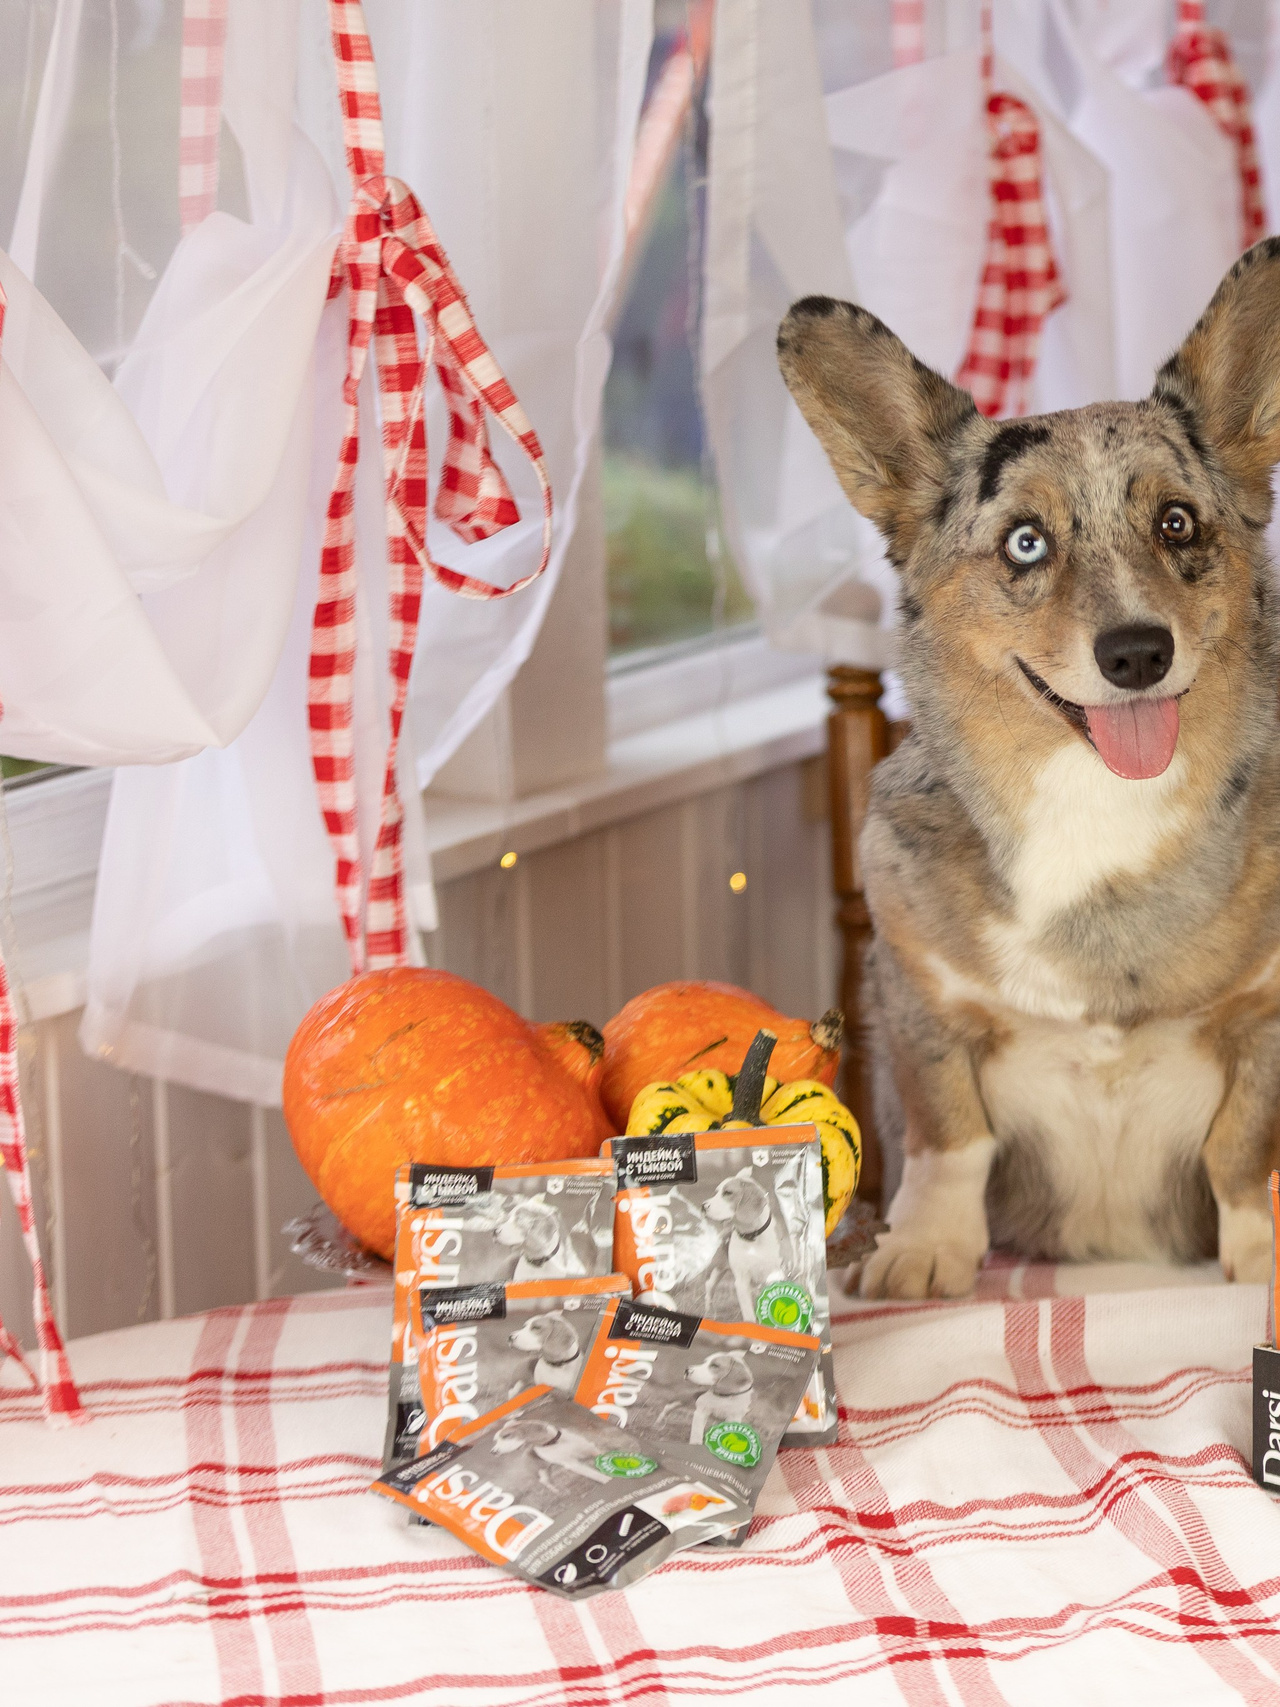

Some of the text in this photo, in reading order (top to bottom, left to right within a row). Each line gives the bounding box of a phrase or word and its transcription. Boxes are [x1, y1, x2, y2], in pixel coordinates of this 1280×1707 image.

[627, 1147, 681, 1164] ИНДЕЙКА
[626, 1158, 683, 1175] С ТЫКВОЙ
[618, 1194, 677, 1311] arsi
[630, 1312, 682, 1332] ИНДЕЙКА
[417, 1464, 555, 1562] Darsi
